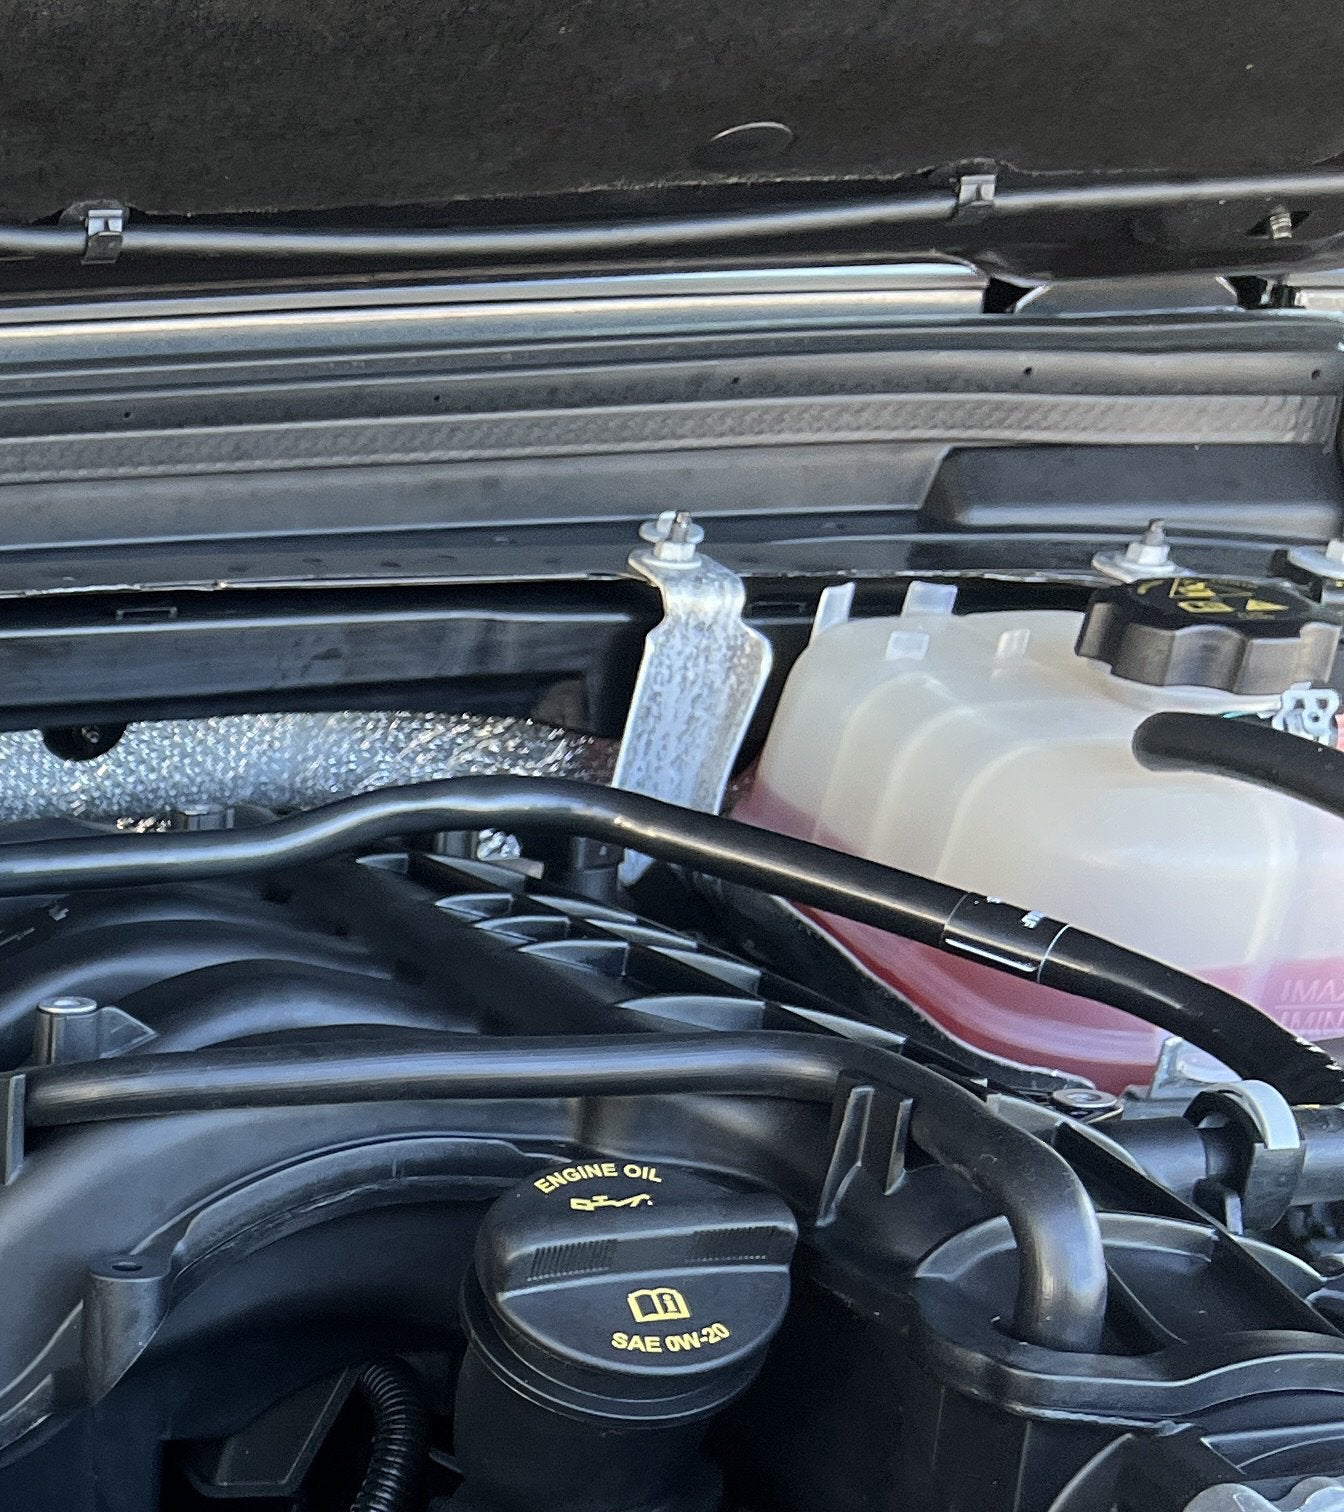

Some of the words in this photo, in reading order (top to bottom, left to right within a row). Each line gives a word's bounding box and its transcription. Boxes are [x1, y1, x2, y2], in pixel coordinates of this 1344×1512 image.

[533, 1162, 618, 1194] ENGINE
[623, 1163, 663, 1184] OIL
[610, 1331, 663, 1354] SAE
[665, 1322, 731, 1353] 0W-20
